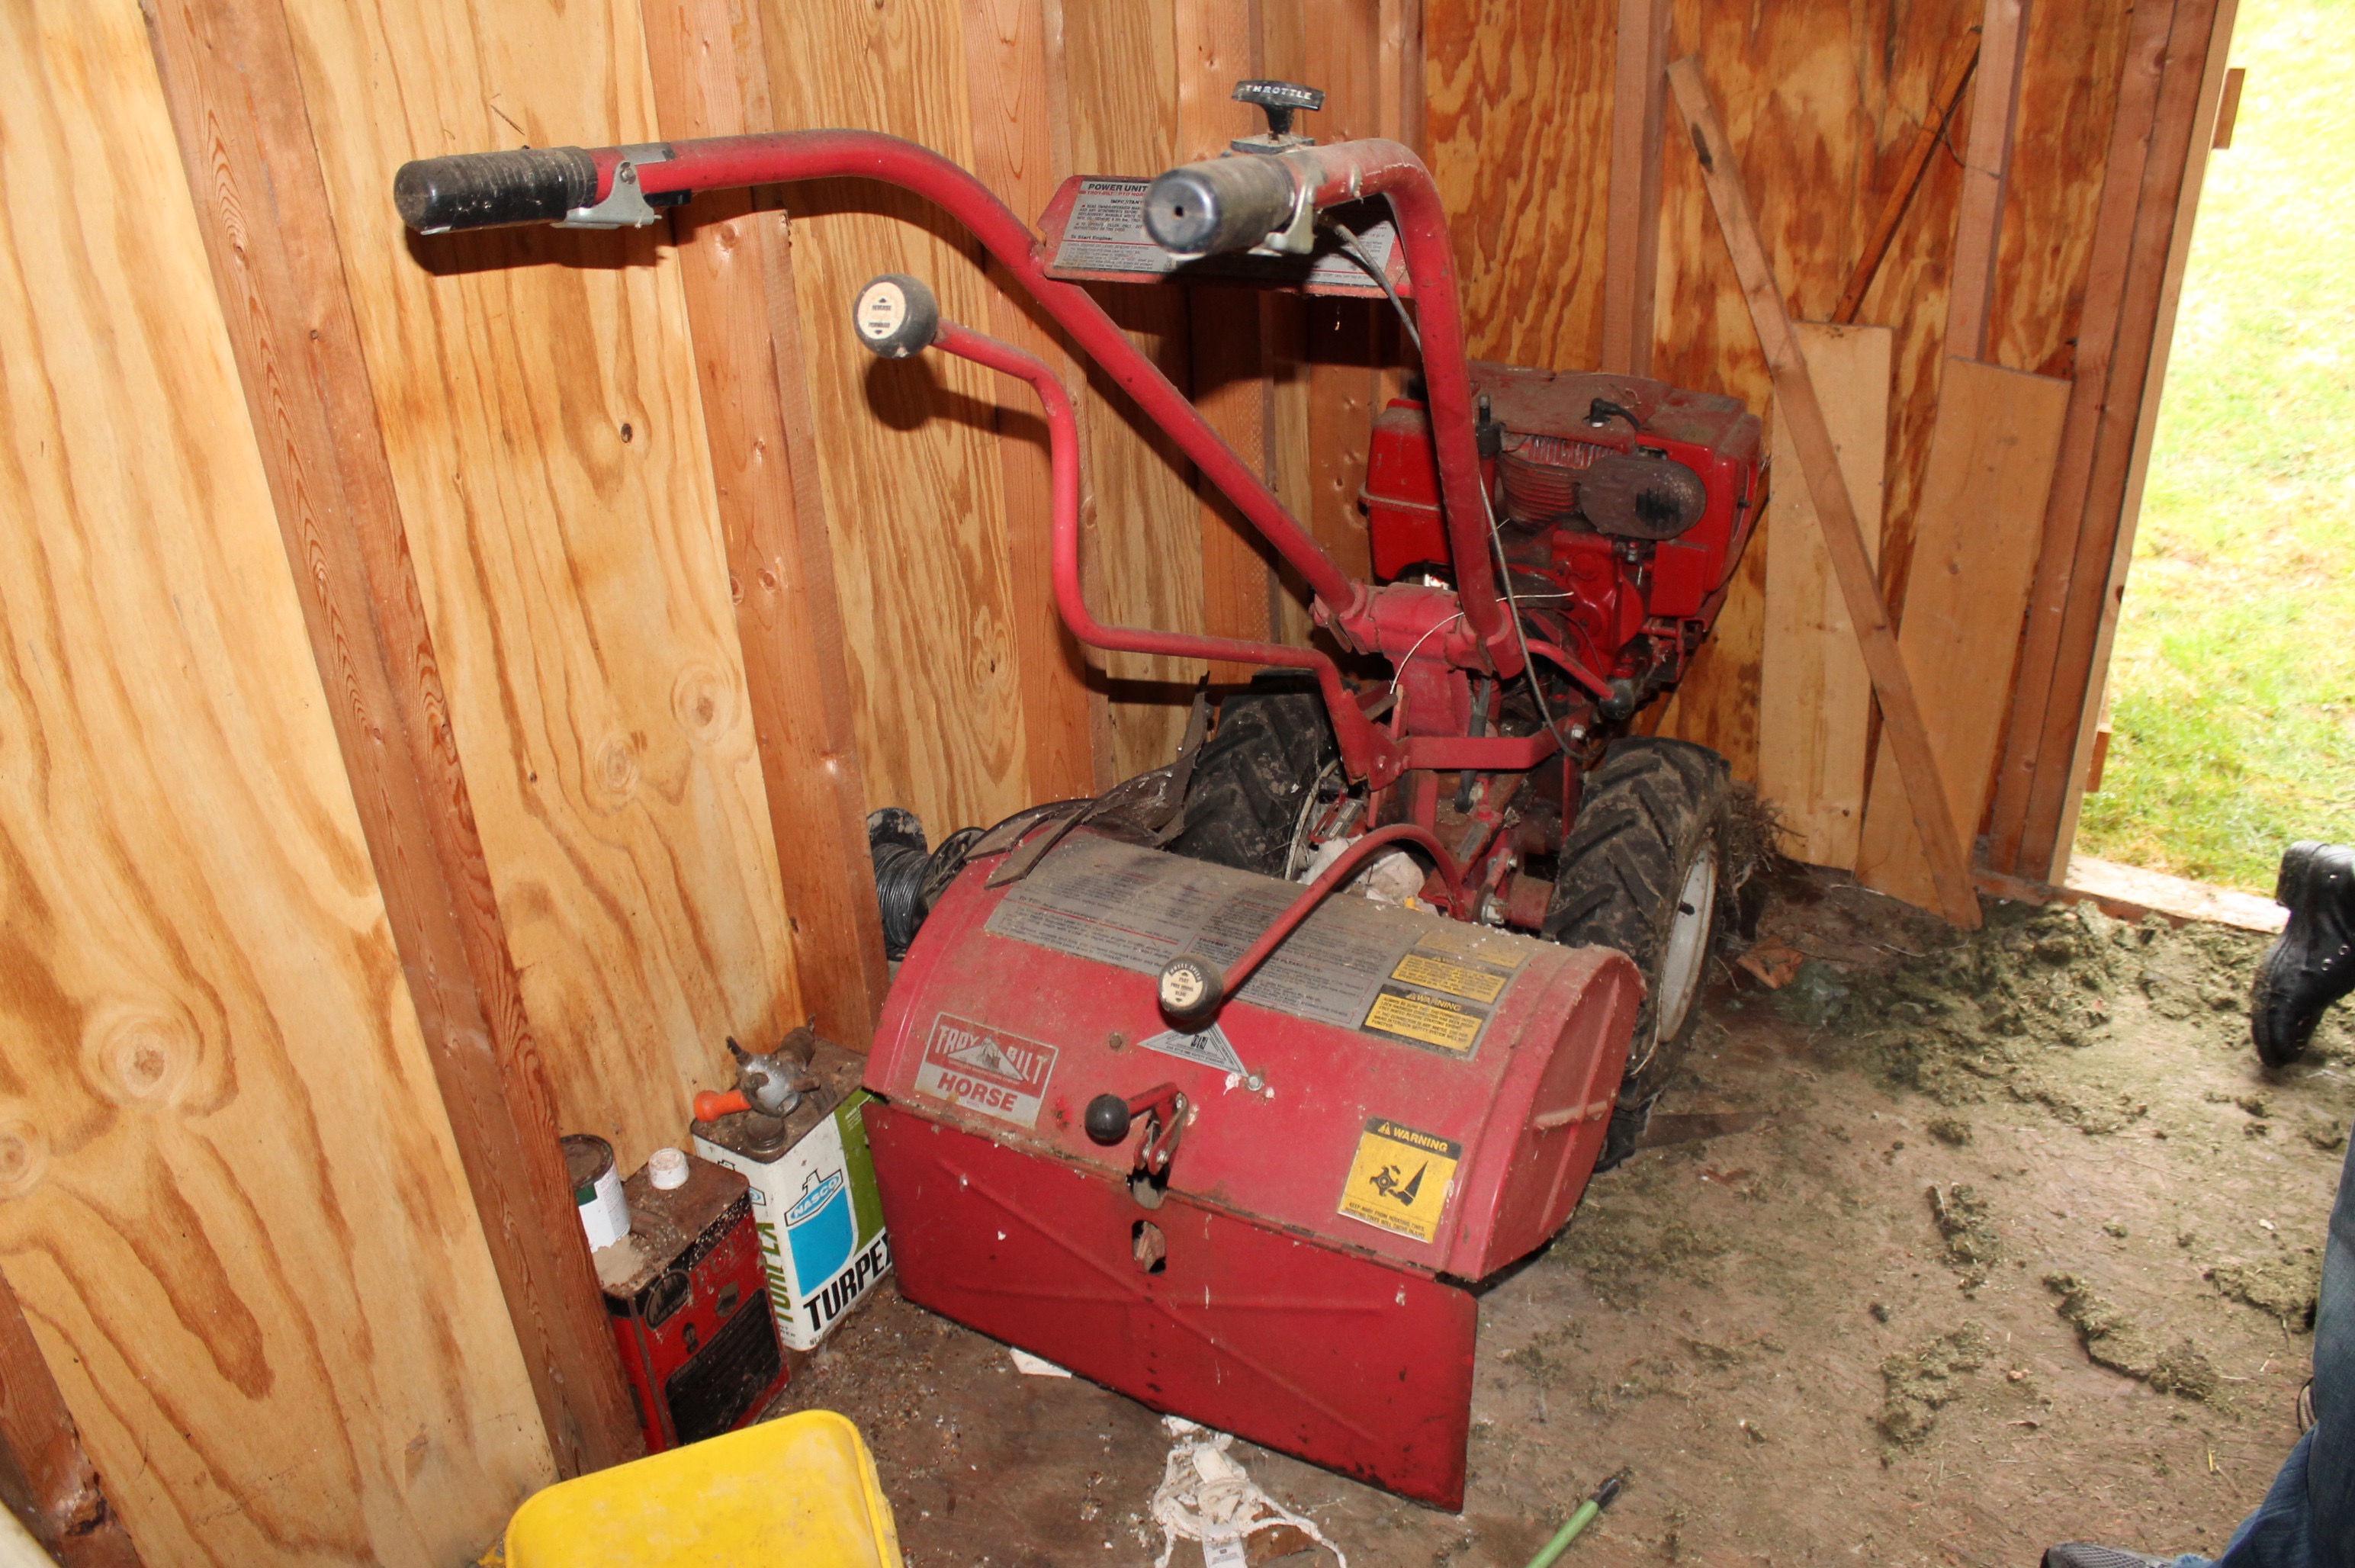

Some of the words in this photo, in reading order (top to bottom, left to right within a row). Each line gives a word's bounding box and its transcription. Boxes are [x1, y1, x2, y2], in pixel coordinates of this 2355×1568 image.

[1245, 85, 1312, 100] THROTTLE
[1088, 183, 1123, 191] POWER
[1170, 963, 1187, 975] WHEEL
[935, 1025, 980, 1054] TROY
[1006, 1046, 1049, 1084] BILT
[937, 1072, 1018, 1112] HORSE
[1393, 1127, 1448, 1153] WARNING
[792, 1175, 839, 1219] NASCO
